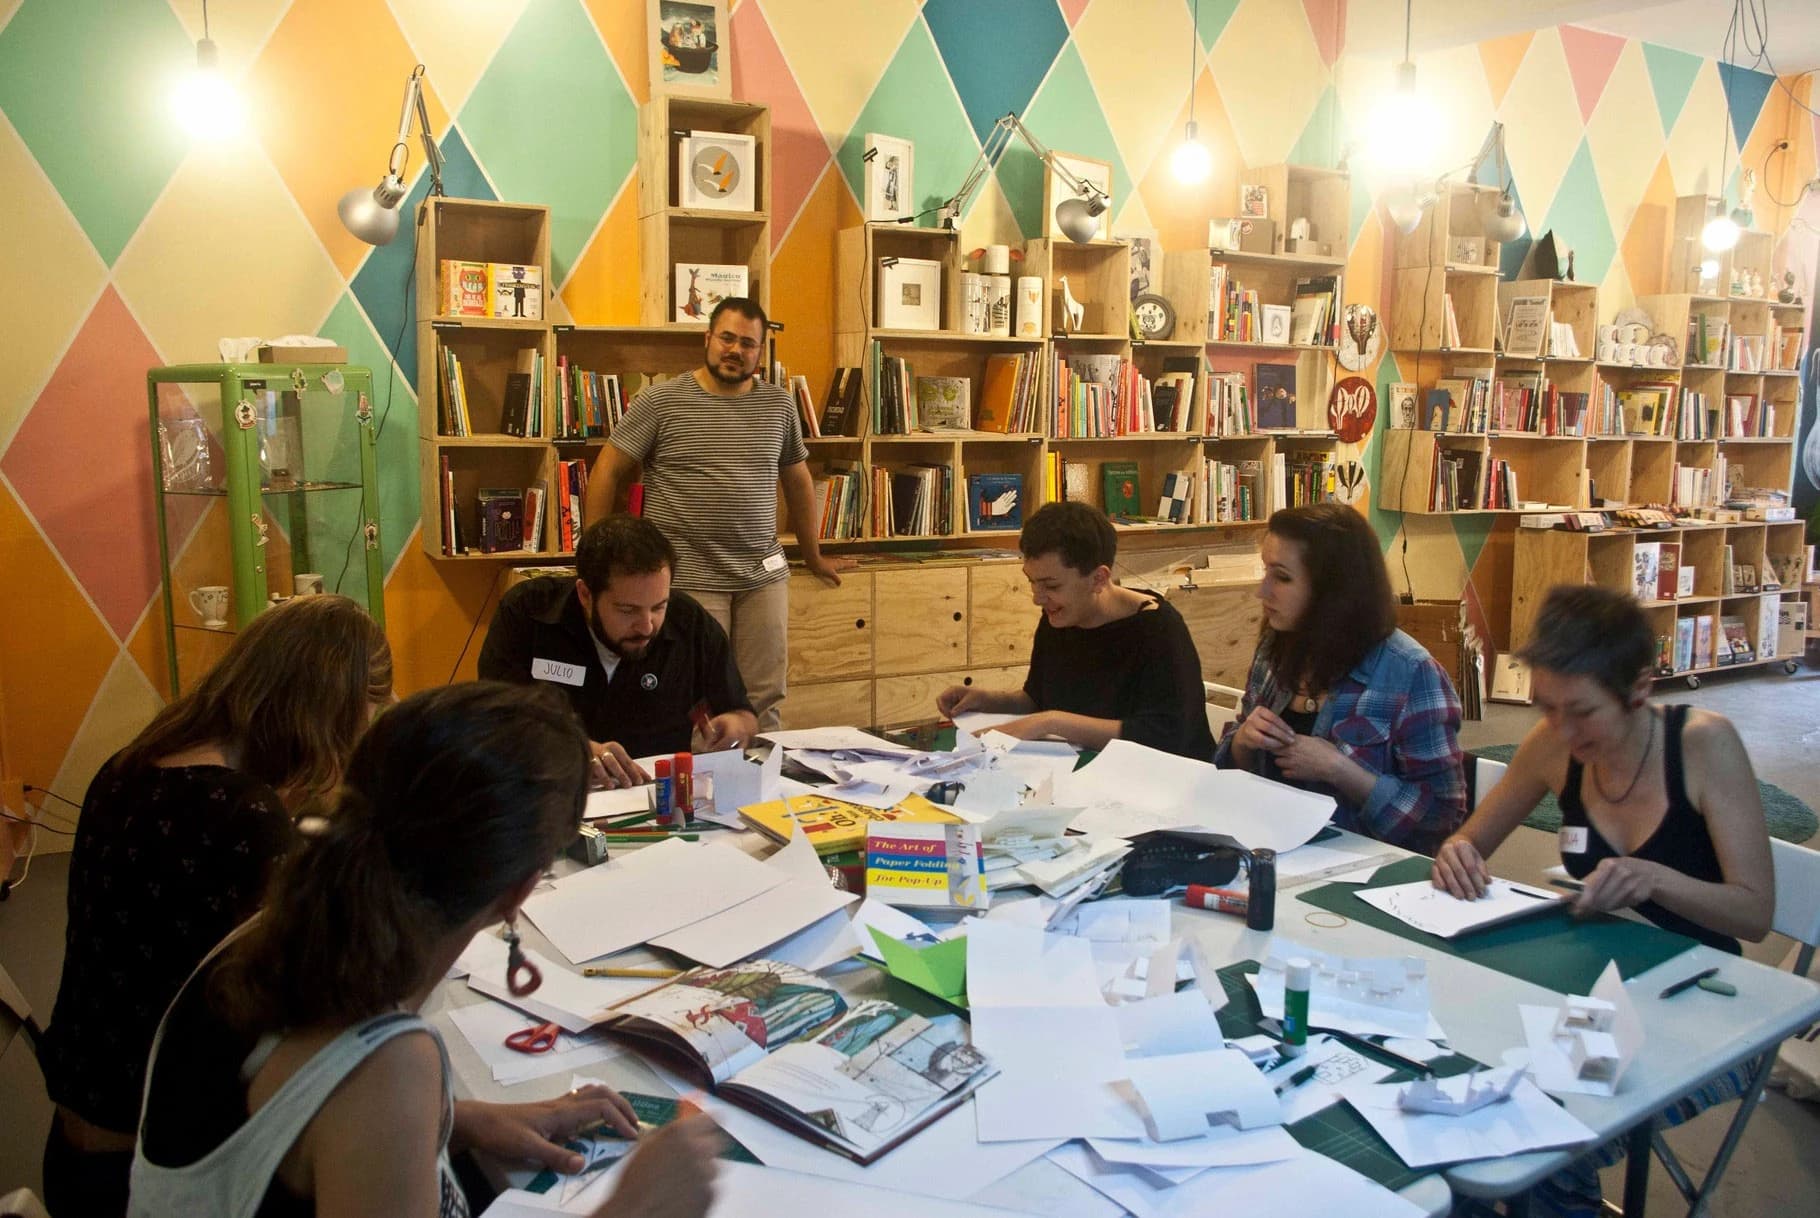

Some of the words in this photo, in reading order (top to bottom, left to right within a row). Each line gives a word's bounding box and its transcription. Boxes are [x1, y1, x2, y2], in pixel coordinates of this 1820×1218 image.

[543, 662, 574, 679] JULIO
[874, 840, 896, 850] The
[899, 842, 919, 852] Art
[922, 844, 936, 853] of
[875, 857, 911, 869] Paper
[875, 874, 895, 882] for
[899, 876, 942, 886] Pop-Up
